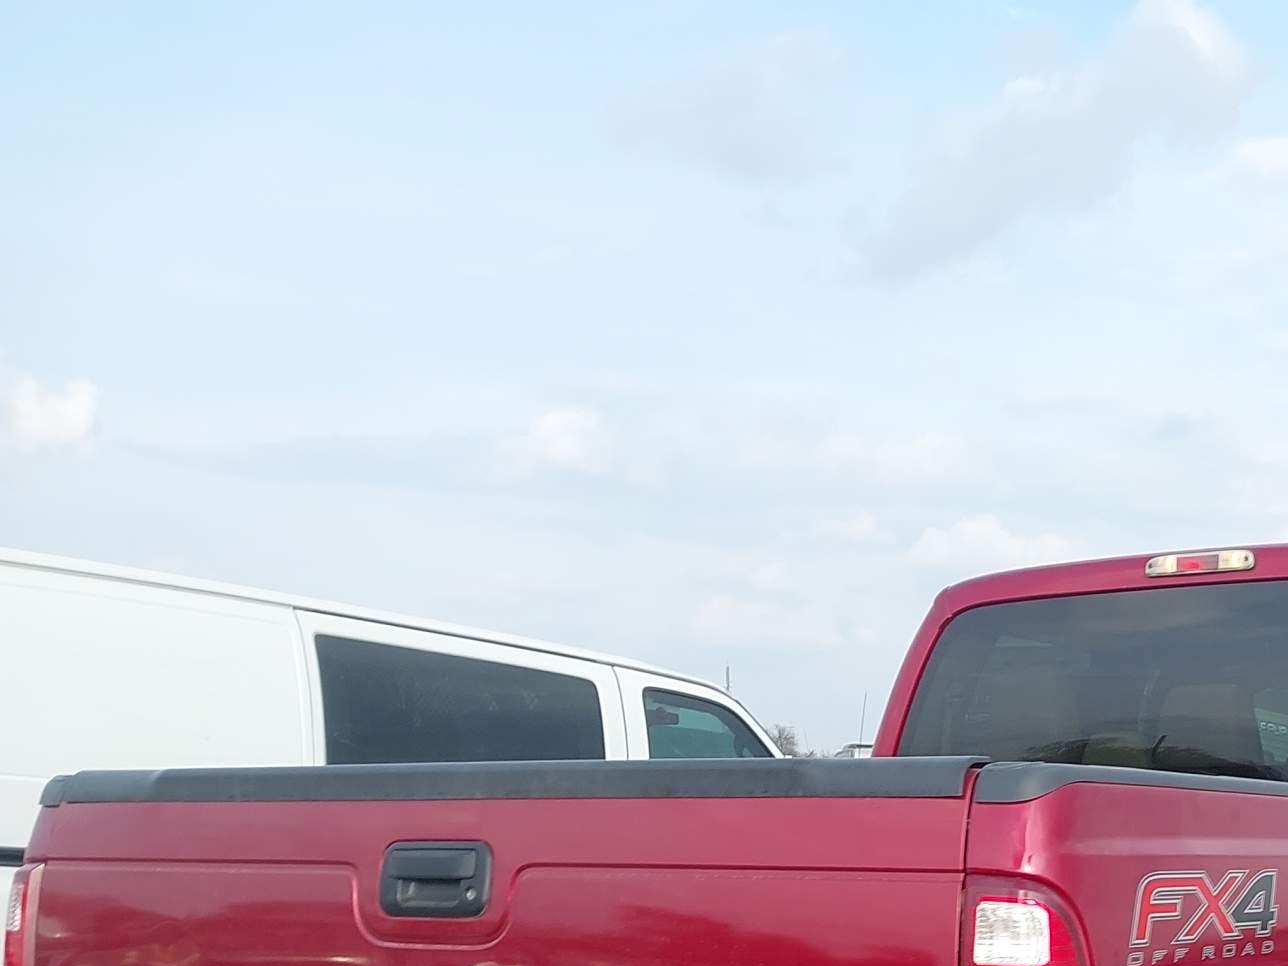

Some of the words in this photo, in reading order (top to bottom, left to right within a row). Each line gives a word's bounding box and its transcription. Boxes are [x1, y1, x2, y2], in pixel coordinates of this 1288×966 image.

[1129, 868, 1279, 948] FX4
[1126, 948, 1189, 966] OFF
[1201, 940, 1275, 961] ROAD
